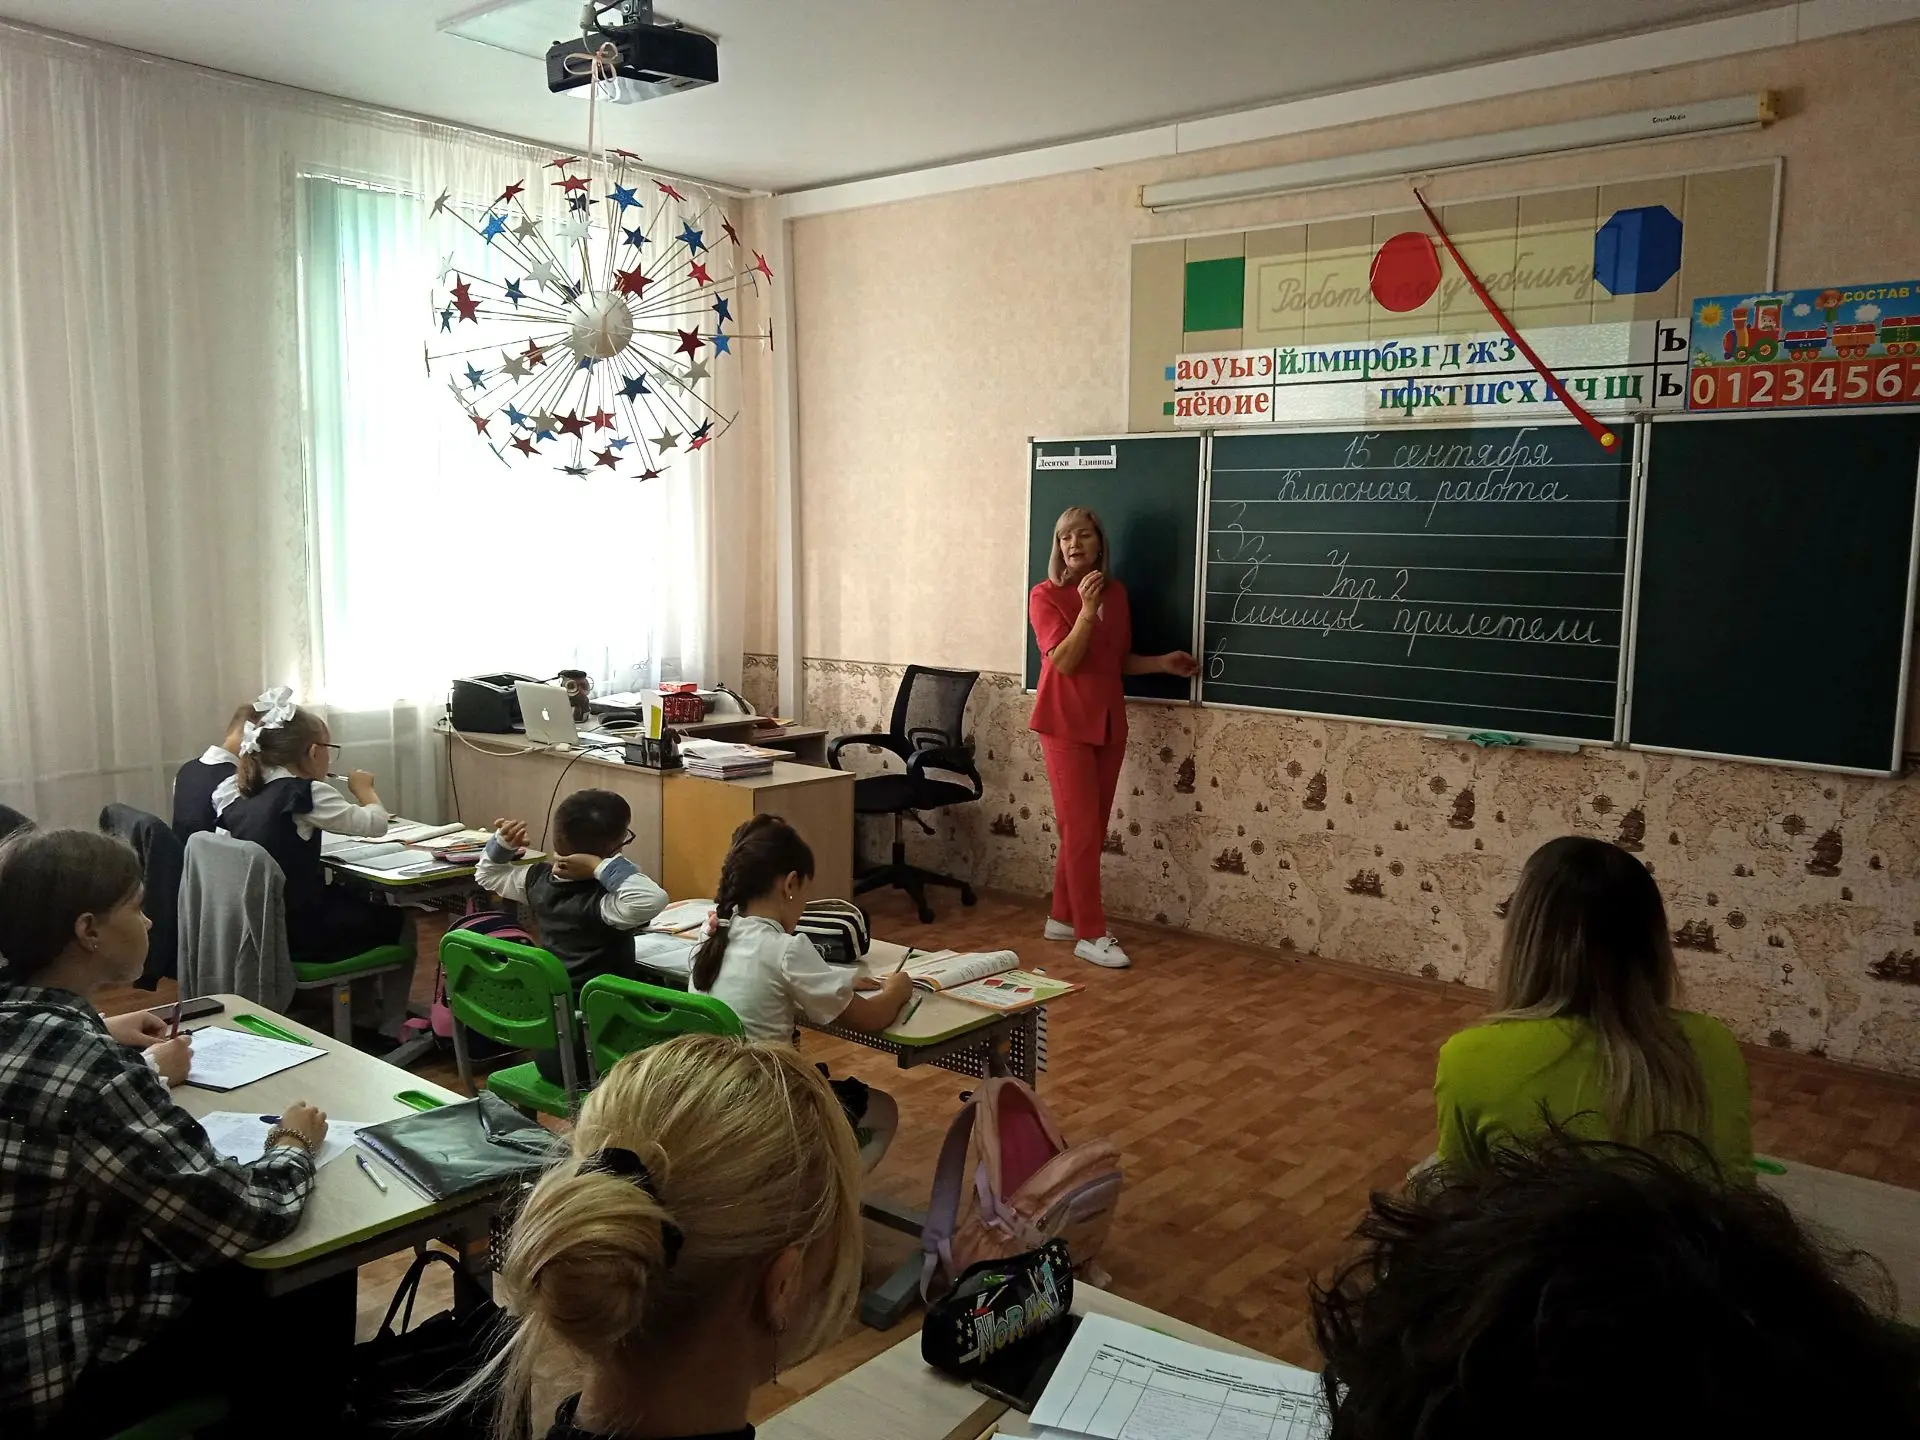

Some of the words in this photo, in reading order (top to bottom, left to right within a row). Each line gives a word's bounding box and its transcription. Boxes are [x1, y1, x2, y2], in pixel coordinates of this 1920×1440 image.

[1842, 287, 1910, 302] СОСТАВ
[1038, 459, 1070, 468] Десятки
[1078, 458, 1114, 467] Единицы
[1343, 433, 1380, 469] 15
[1393, 427, 1554, 487] сентября
[1277, 469, 1418, 502] Классная
[1424, 469, 1569, 528] работа
[1322, 549, 1377, 620] Упр.
[1390, 568, 1409, 602] 2
[1232, 588, 1364, 637] Синицы
[1393, 607, 1602, 657] прилетели
